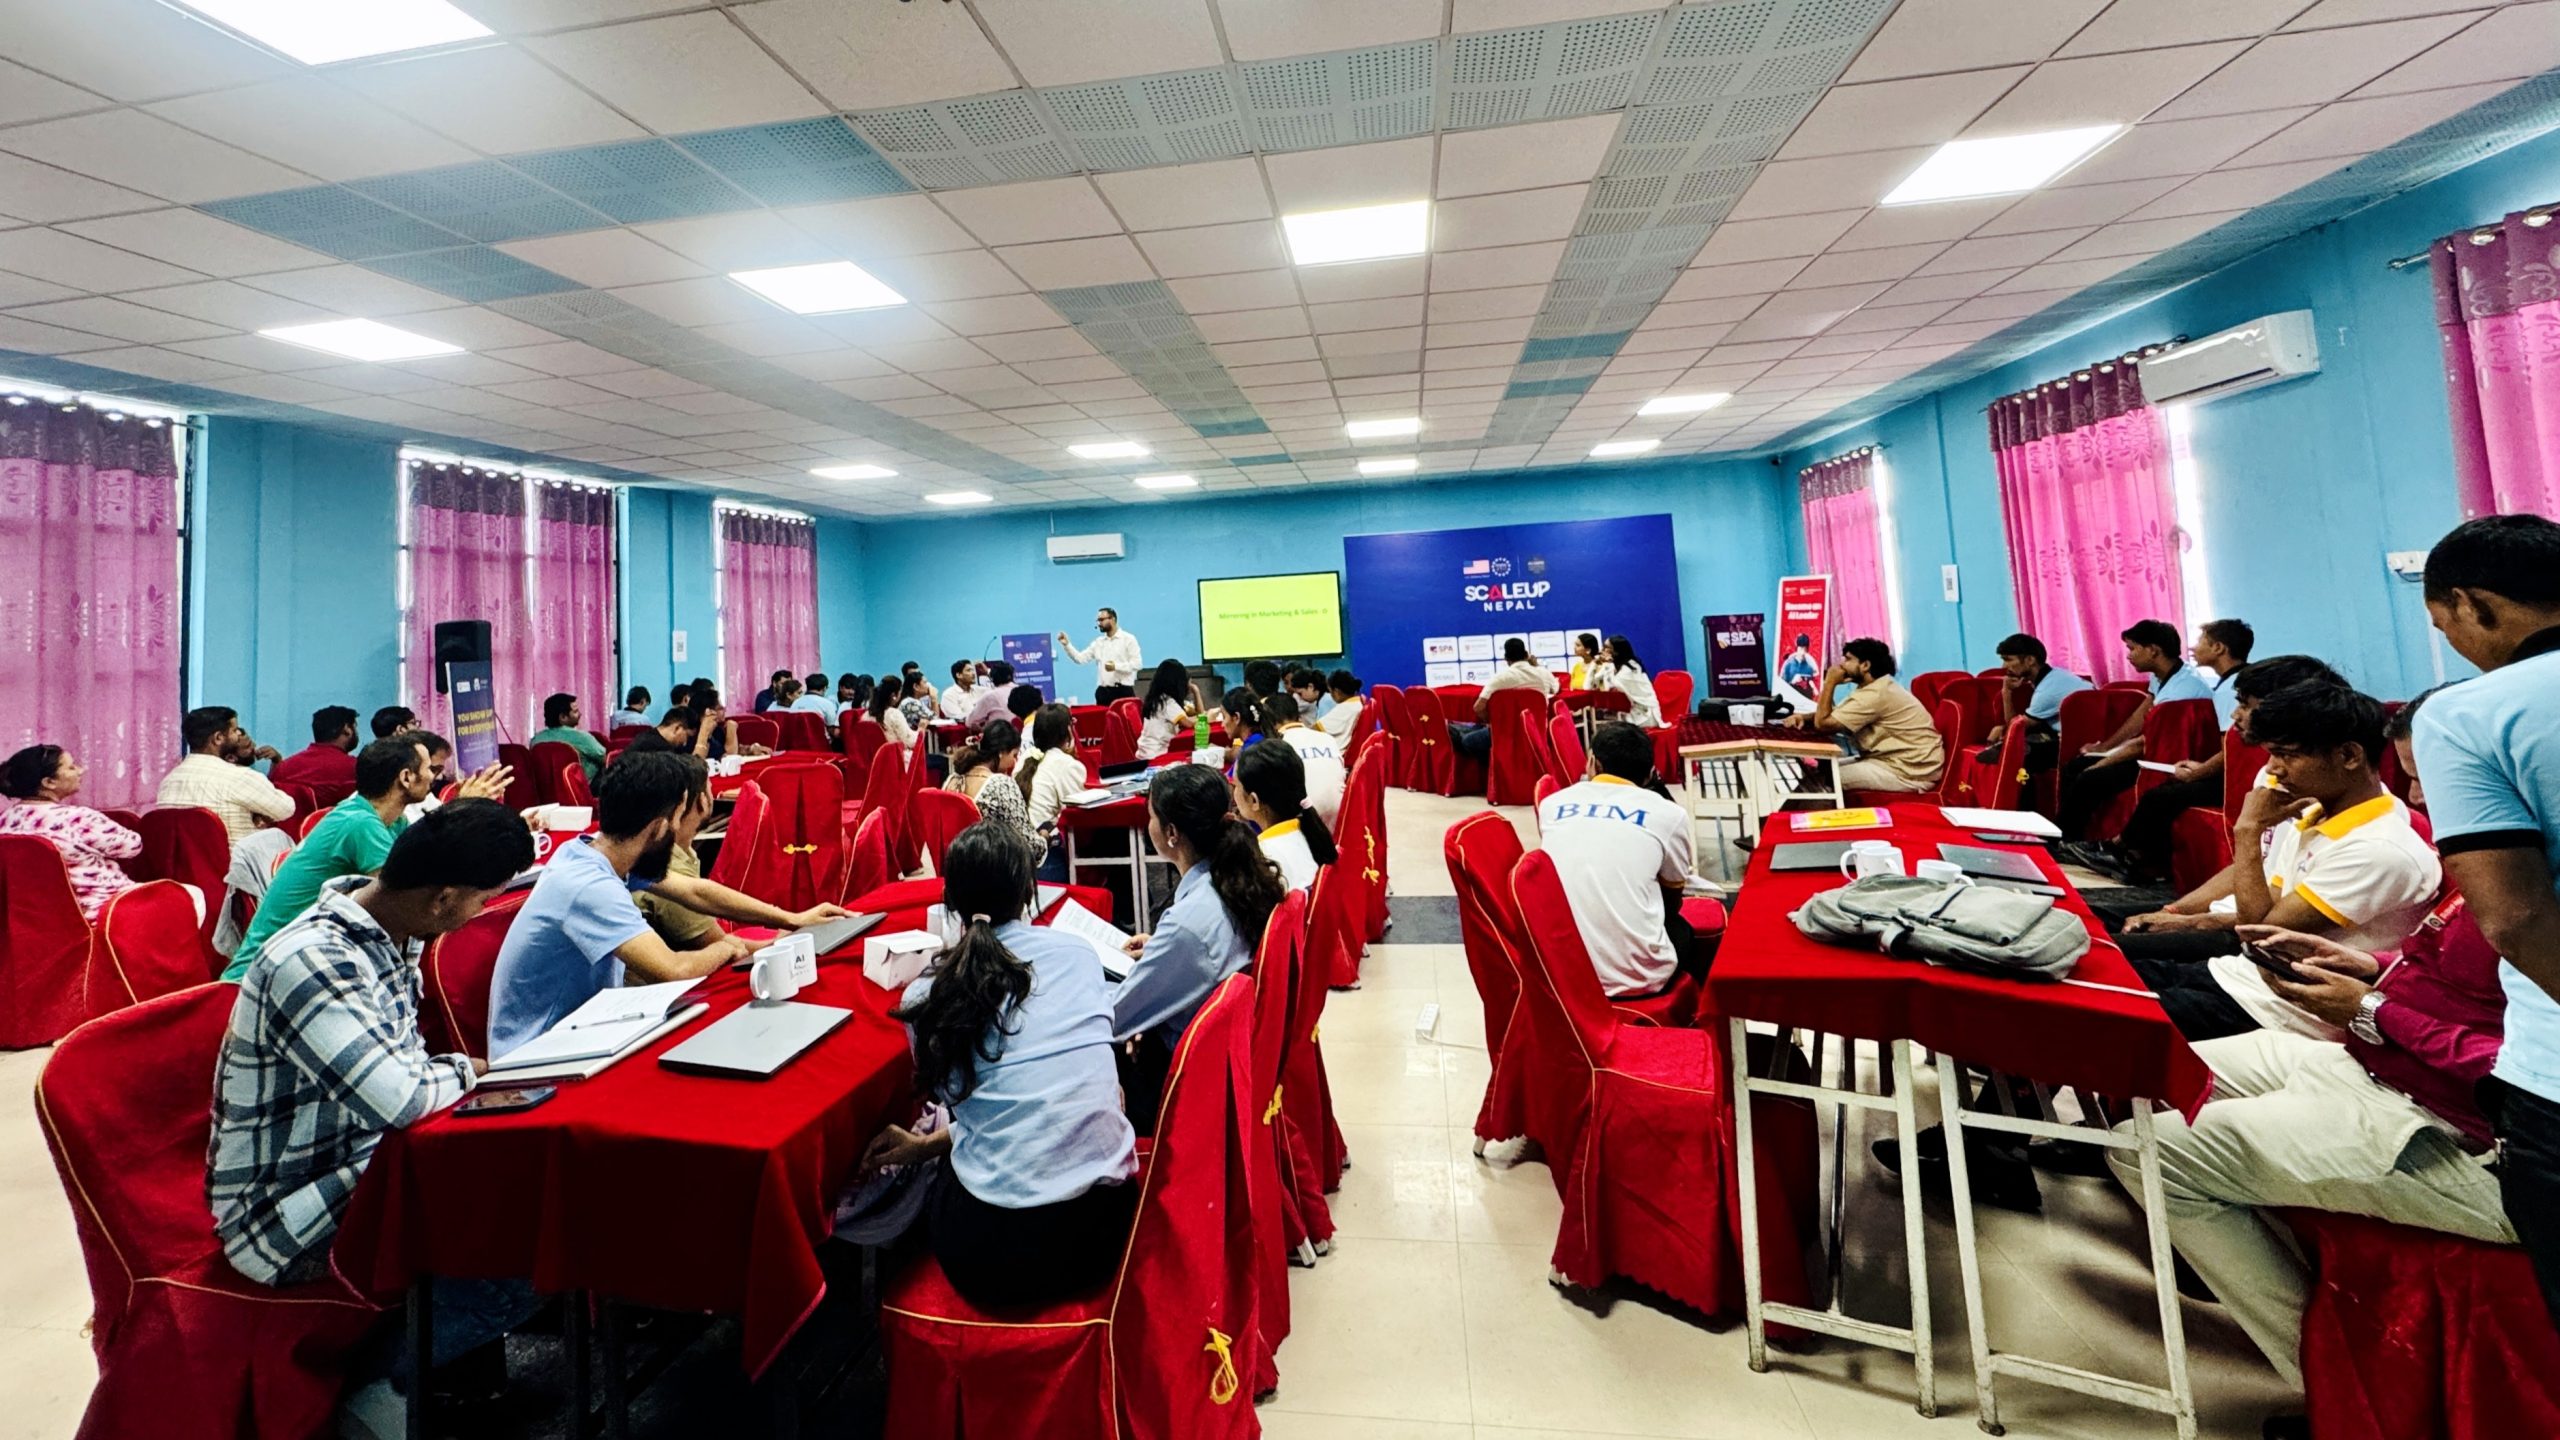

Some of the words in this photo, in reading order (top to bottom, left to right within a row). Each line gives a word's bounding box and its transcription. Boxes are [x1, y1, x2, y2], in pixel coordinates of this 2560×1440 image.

[1464, 581, 1550, 602] SCALEUP
[1483, 600, 1535, 612] NEPAL
[1730, 631, 1755, 642] SPA
[1554, 803, 1650, 828] BIM
